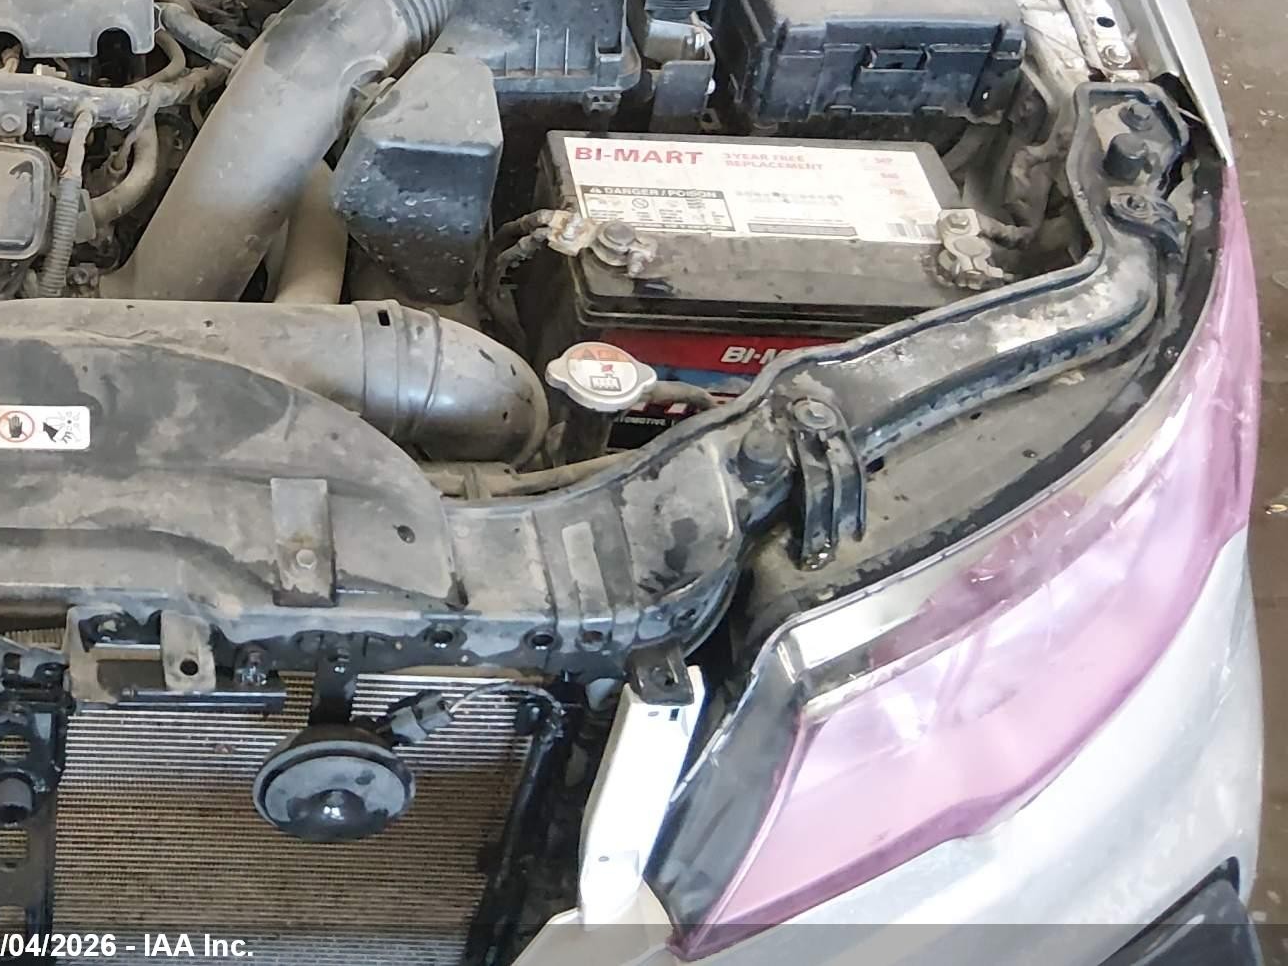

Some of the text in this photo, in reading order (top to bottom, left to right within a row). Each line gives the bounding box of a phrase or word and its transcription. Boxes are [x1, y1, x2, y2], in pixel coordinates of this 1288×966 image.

[575, 147, 704, 165] BI-MART
[725, 160, 824, 171] REPLACEMENT
[605, 187, 659, 198] DANGER
[668, 189, 718, 199] POISON
